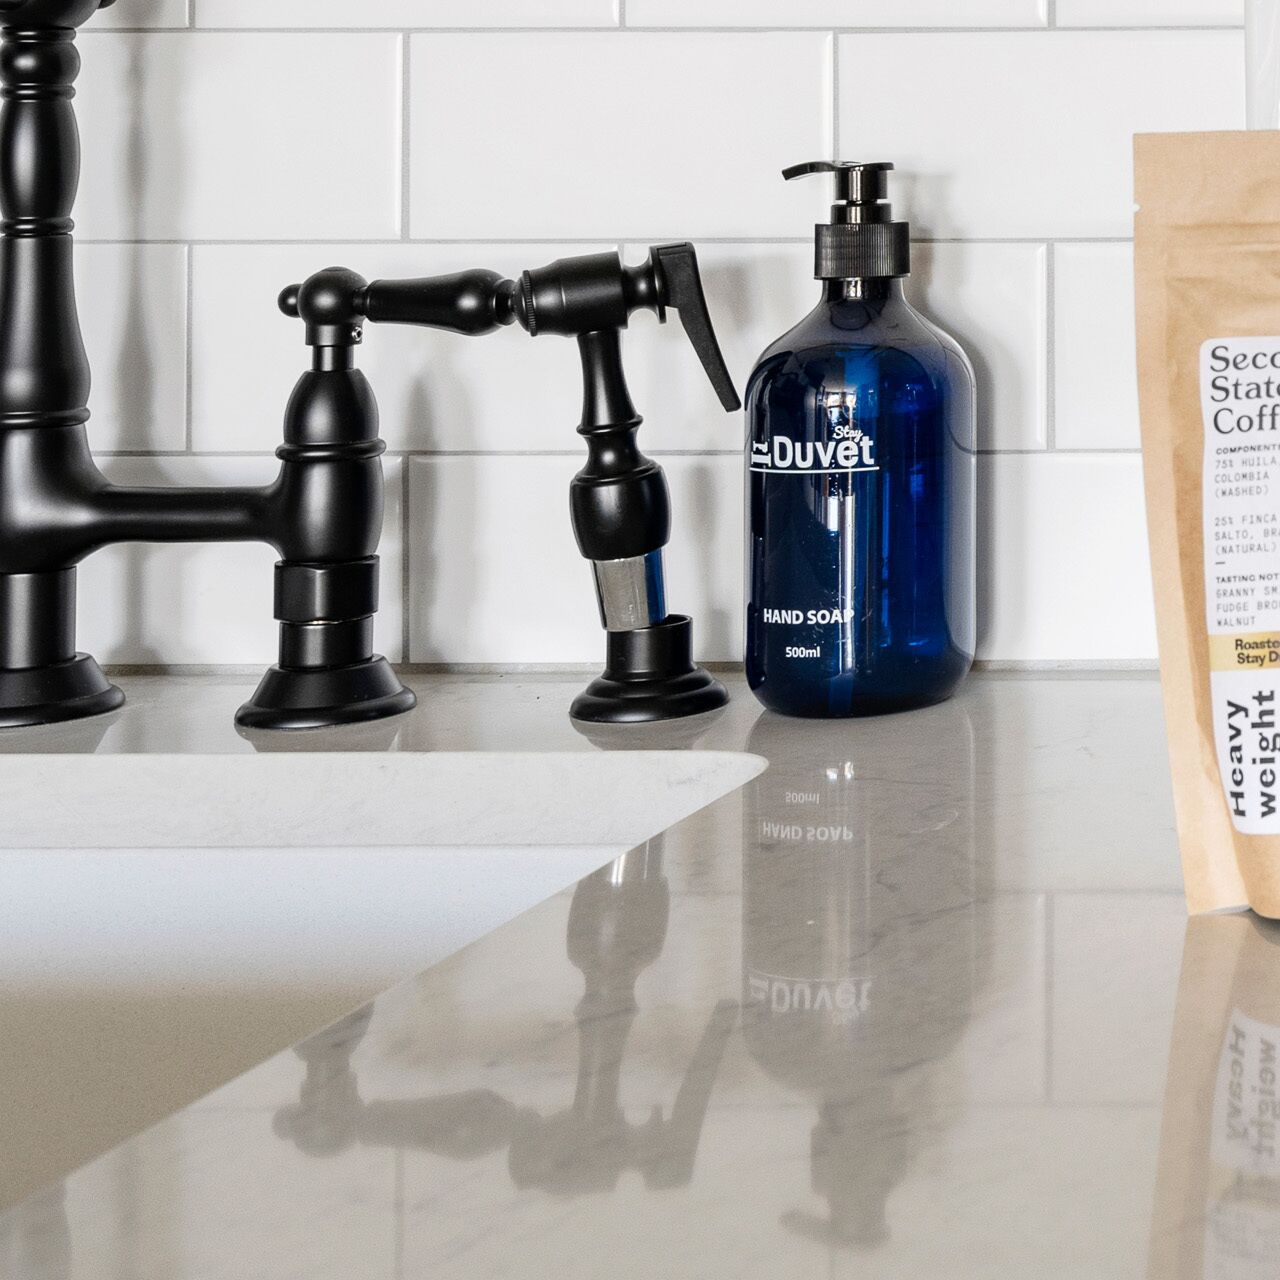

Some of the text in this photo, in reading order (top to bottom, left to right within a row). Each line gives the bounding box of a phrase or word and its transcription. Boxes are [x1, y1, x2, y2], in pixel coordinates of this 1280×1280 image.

[832, 425, 863, 442] Stay
[773, 435, 875, 469] Duvet
[1214, 471, 1270, 484] COLOMBIA
[1215, 484, 1269, 499] (WASHED)
[1241, 513, 1277, 525] FINCA
[1215, 542, 1277, 556] (NATURAL)
[763, 607, 855, 624] HAND SOAP
[785, 646, 820, 658] 500ml
[1237, 652, 1266, 667] Stay
[1227, 700, 1249, 817] Heavy
